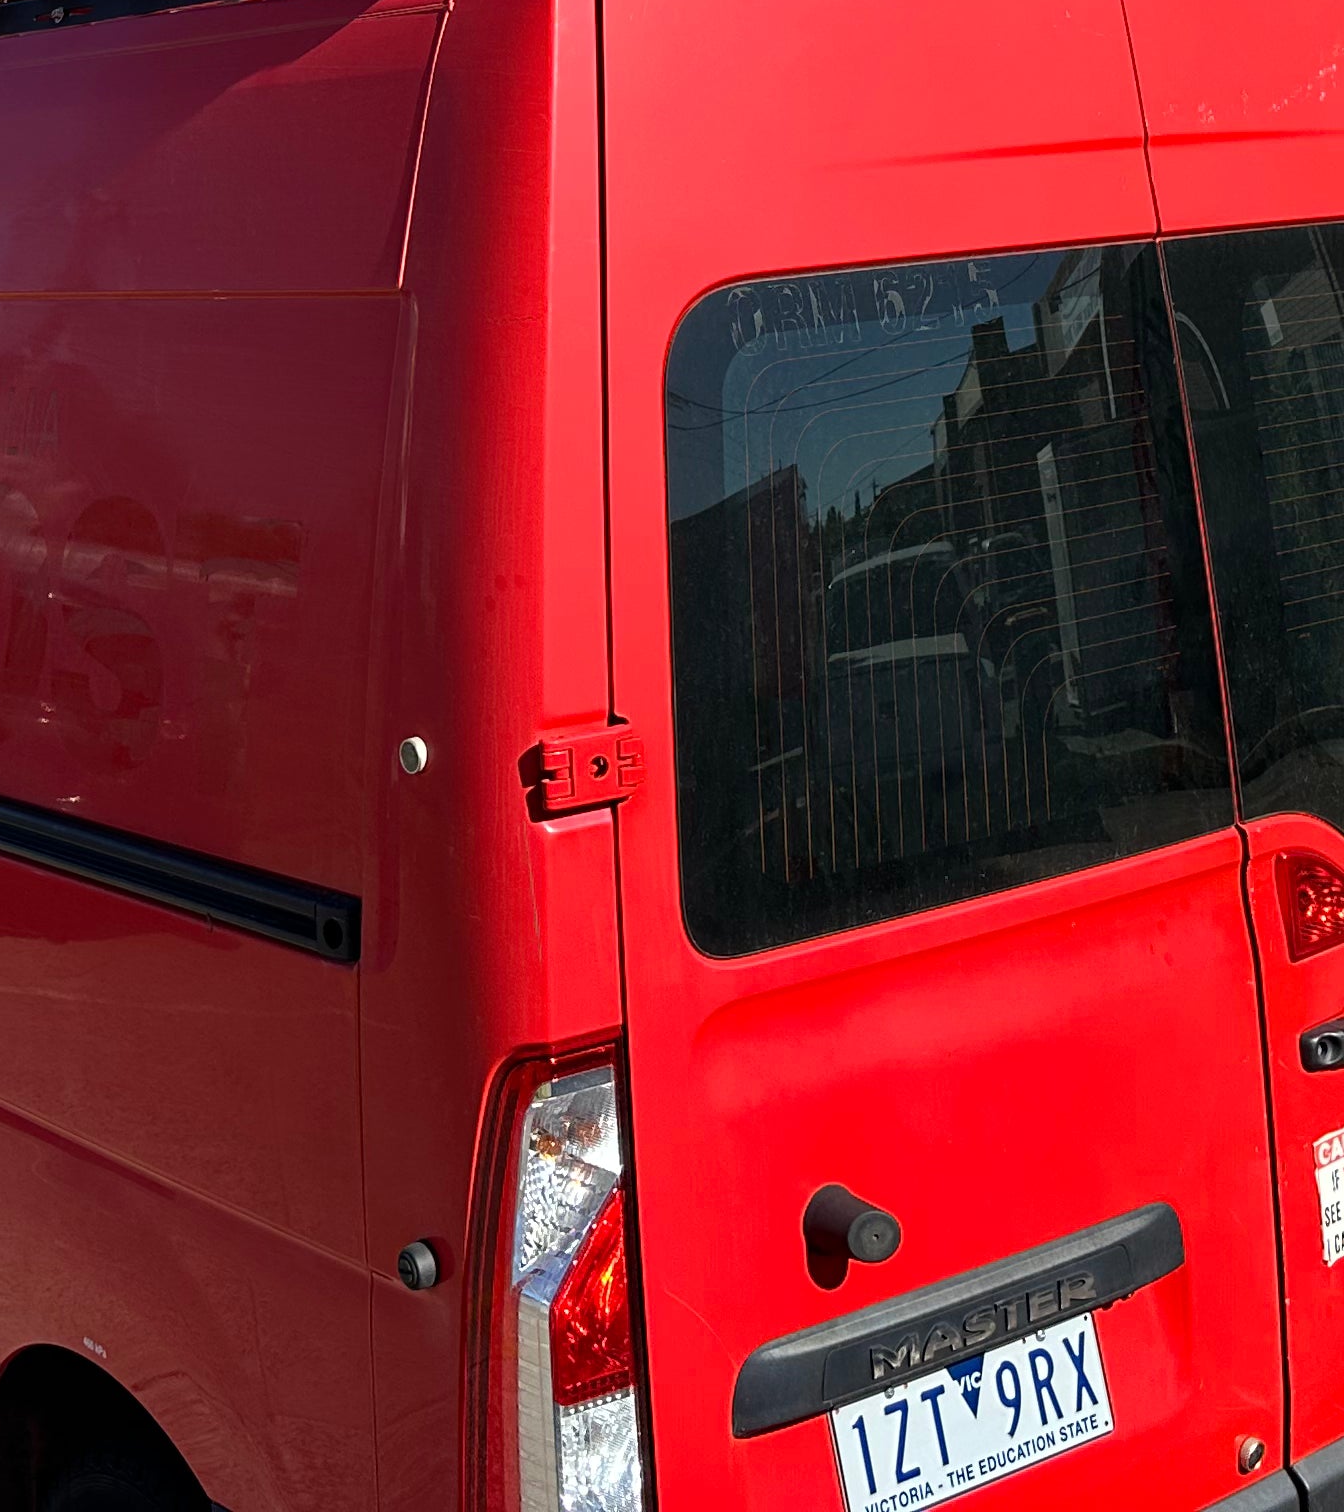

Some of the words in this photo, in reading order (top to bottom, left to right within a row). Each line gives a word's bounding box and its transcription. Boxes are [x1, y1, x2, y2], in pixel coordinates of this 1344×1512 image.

[1324, 1201, 1342, 1227] SEE
[869, 1270, 1098, 1380] MASTER
[852, 1384, 950, 1495] 1ZT
[995, 1331, 1099, 1439] 9RX
[956, 1370, 982, 1392] VIC
[947, 1464, 975, 1488] THE
[979, 1431, 1056, 1475] EDUCATION
[1059, 1414, 1099, 1442] STATE
